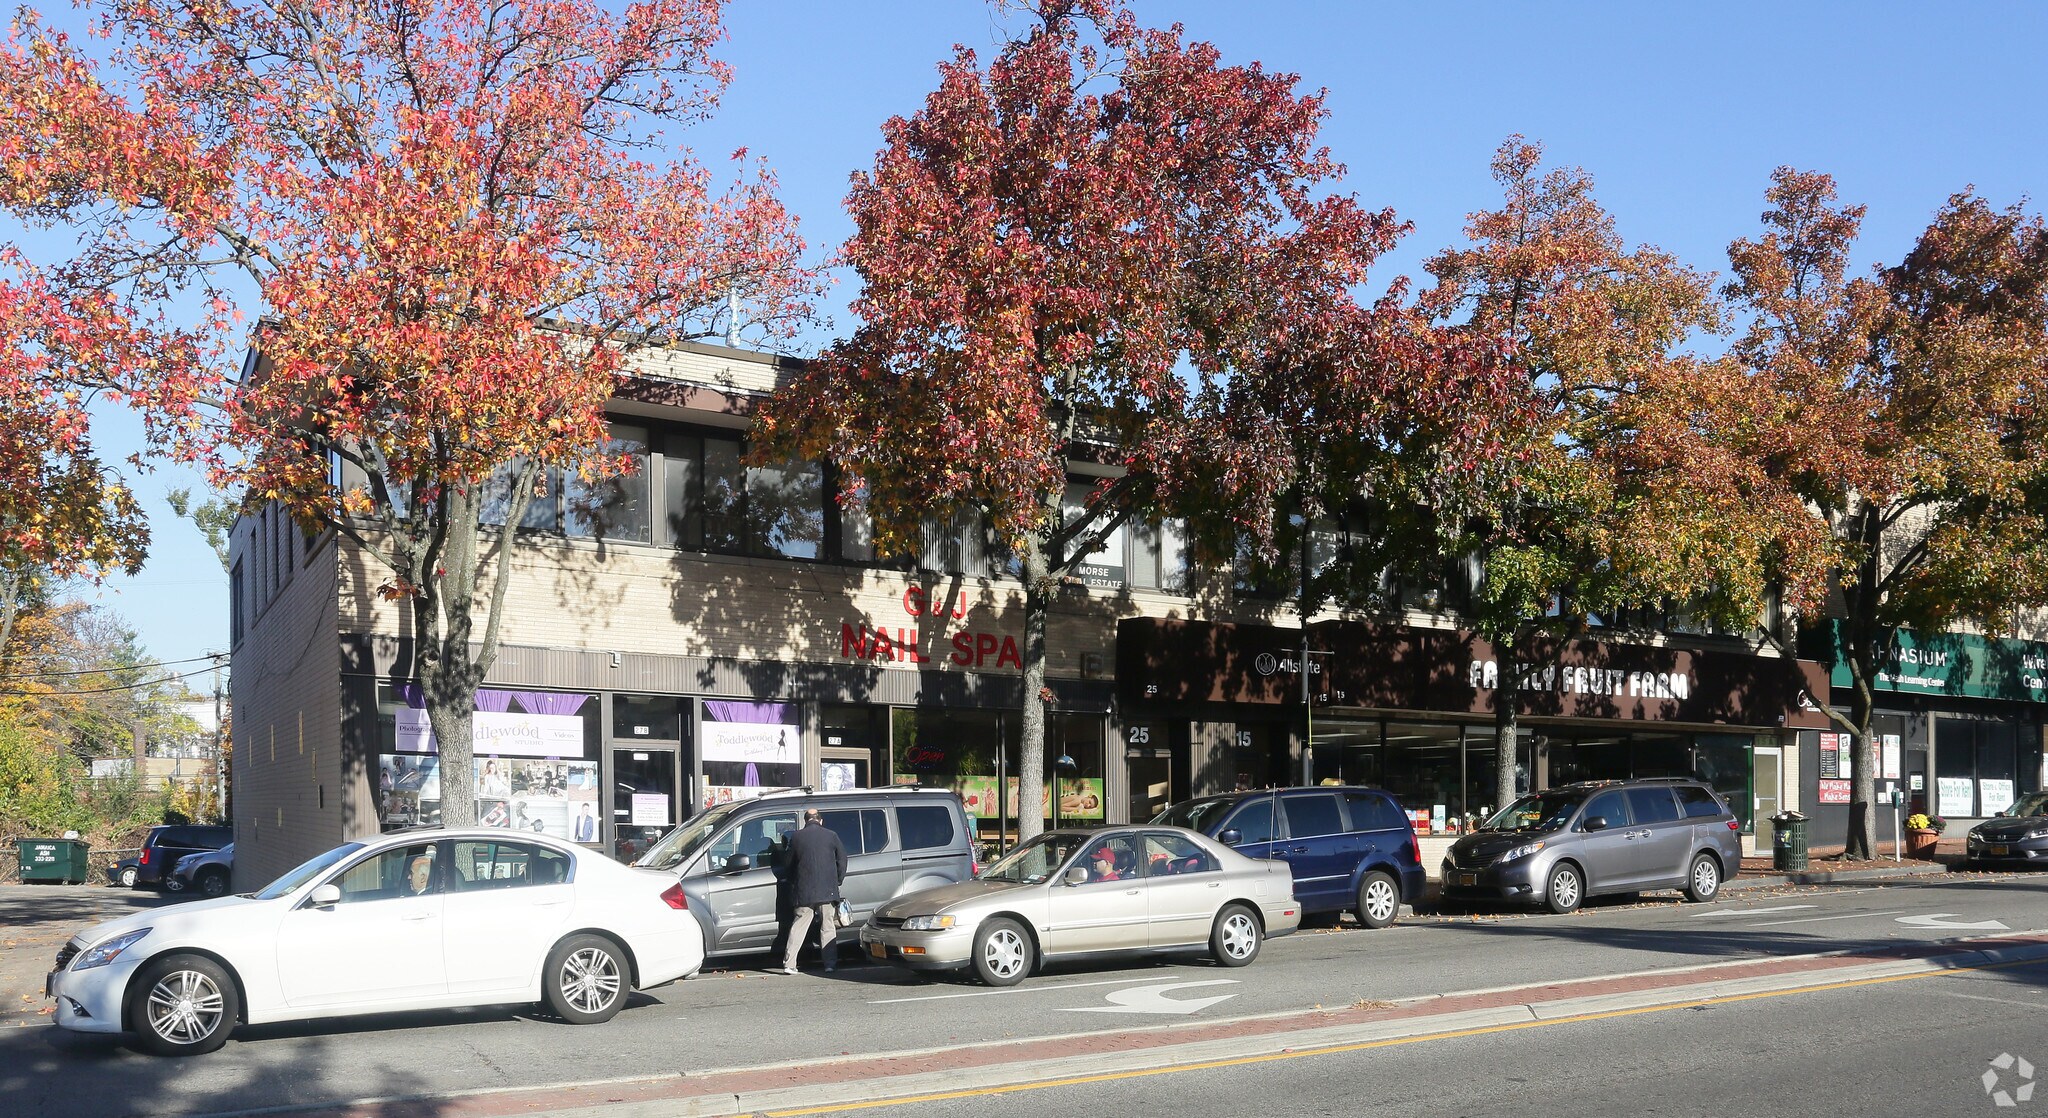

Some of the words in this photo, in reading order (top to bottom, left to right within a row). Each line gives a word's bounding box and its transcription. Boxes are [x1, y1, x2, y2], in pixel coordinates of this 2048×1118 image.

[1079, 566, 1110, 577] MORSE
[1091, 579, 1123, 589] ESTATE
[903, 586, 926, 617] G
[933, 601, 944, 617] &
[951, 591, 967, 619] J
[841, 623, 931, 664] NAIL
[951, 631, 1023, 670] SPA
[1278, 658, 1321, 674] Allstte
[1470, 660, 1556, 691] FAILY
[1562, 666, 1625, 695] FRUIT
[1630, 671, 1688, 699] FARM
[1878, 672, 1890, 681] The
[1904, 675, 1928, 687] Learning
[1928, 677, 1945, 687] Center
[1146, 685, 1158, 693] 25
[1336, 690, 1346, 699] 15
[1319, 693, 1328, 702] 15
[717, 734, 774, 745] Toddlewood
[1129, 726, 1150, 744] 25
[1236, 731, 1252, 747] 15
[908, 747, 945, 763] Open
[1940, 781, 1953, 798] Store
[1953, 781, 1961, 798] For
[1962, 782, 1972, 799] Rent
[1982, 782, 1994, 791] Store
[1998, 782, 2011, 791] Office
